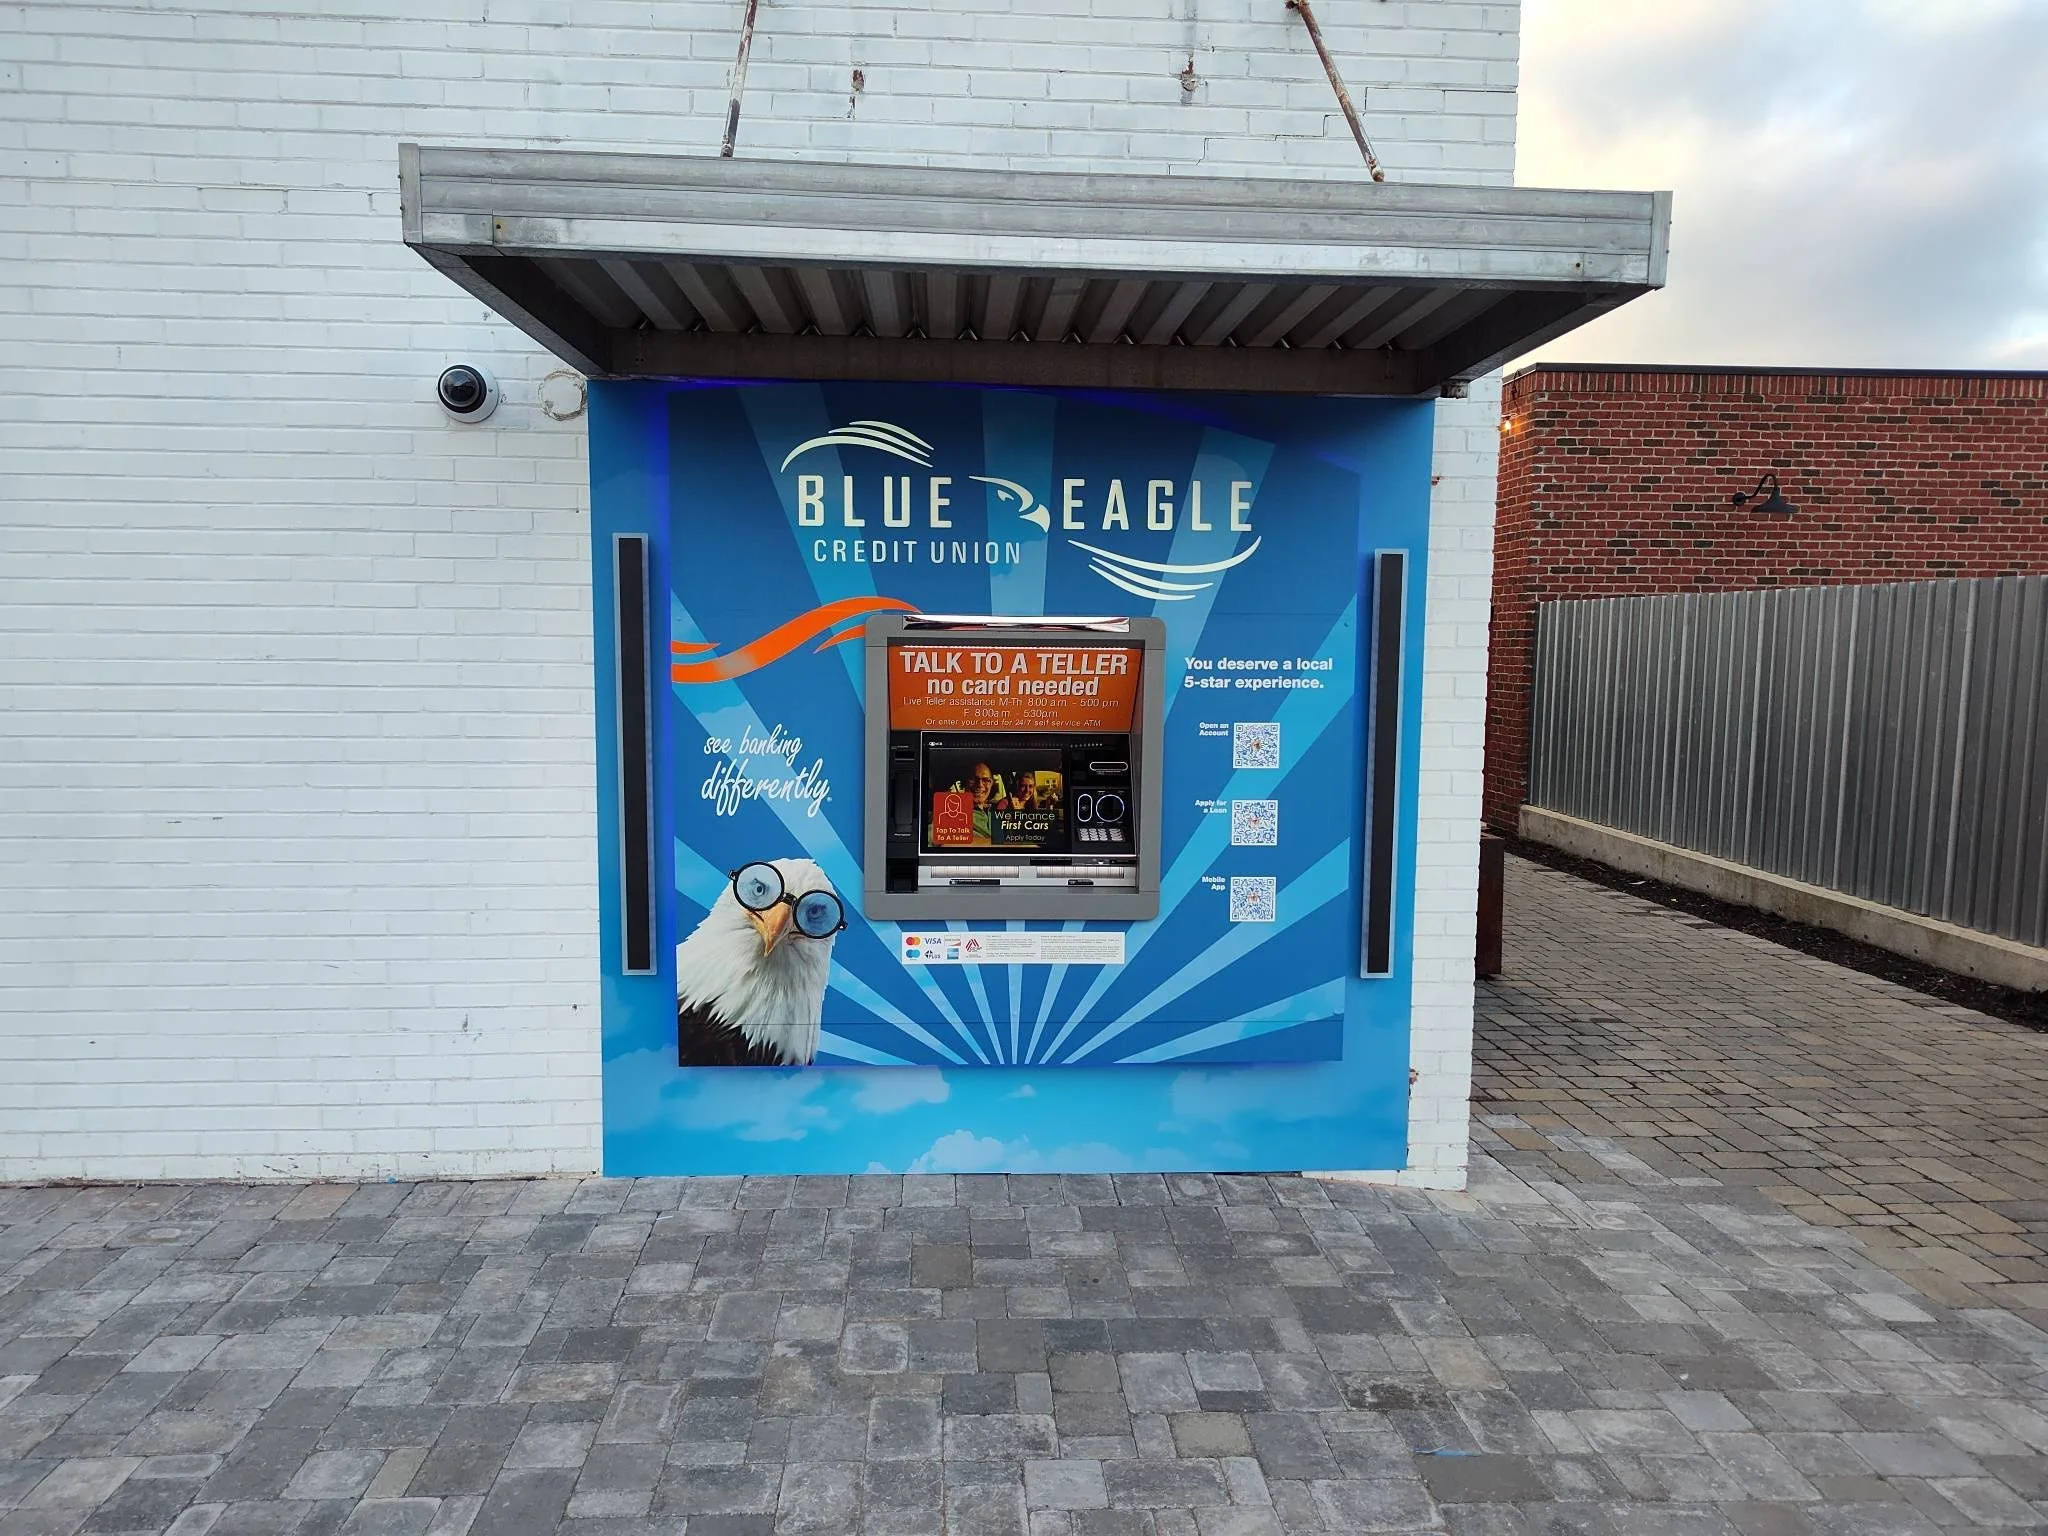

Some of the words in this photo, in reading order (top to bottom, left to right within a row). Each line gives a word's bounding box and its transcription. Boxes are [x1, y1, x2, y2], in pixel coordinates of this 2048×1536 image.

[798, 475, 953, 528] BLUE
[1063, 478, 1254, 532] EAGLE
[813, 539, 918, 564] CREDIT
[930, 541, 1021, 564] UNION
[900, 651, 963, 674] TALK
[970, 652, 1003, 674] TO
[1010, 653, 1029, 674] A
[1034, 653, 1128, 675] TELLER
[1184, 657, 1213, 670] You
[1217, 657, 1279, 671] deserve
[1282, 660, 1292, 671] a
[1296, 657, 1333, 671] local
[927, 678, 953, 695] no
[961, 676, 1010, 695] card
[1018, 677, 1099, 697] needed
[1184, 675, 1231, 689] 5-star
[1234, 675, 1325, 691] experience.
[903, 696, 921, 706] Live
[924, 696, 946, 706] Teller
[949, 697, 996, 706] assistance
[999, 697, 1022, 707] M-Th
[1027, 697, 1048, 707] 8:00
[1080, 698, 1099, 707] 5:00
[938, 718, 958, 726] enter
[961, 719, 979, 727] your
[981, 718, 999, 726] card
[1084, 720, 1102, 728] ATM
[1199, 722, 1218, 730] Open
[1199, 729, 1229, 737] Account
[704, 736, 732, 754] see
[739, 723, 803, 767] banking
[1195, 799, 1214, 807] Apply
[994, 811, 1012, 820] We
[1014, 810, 1056, 821] Finance
[1001, 820, 1022, 830] First
[1024, 821, 1049, 830] Cars
[1005, 834, 1024, 842] Apply
[1025, 834, 1045, 842] Today
